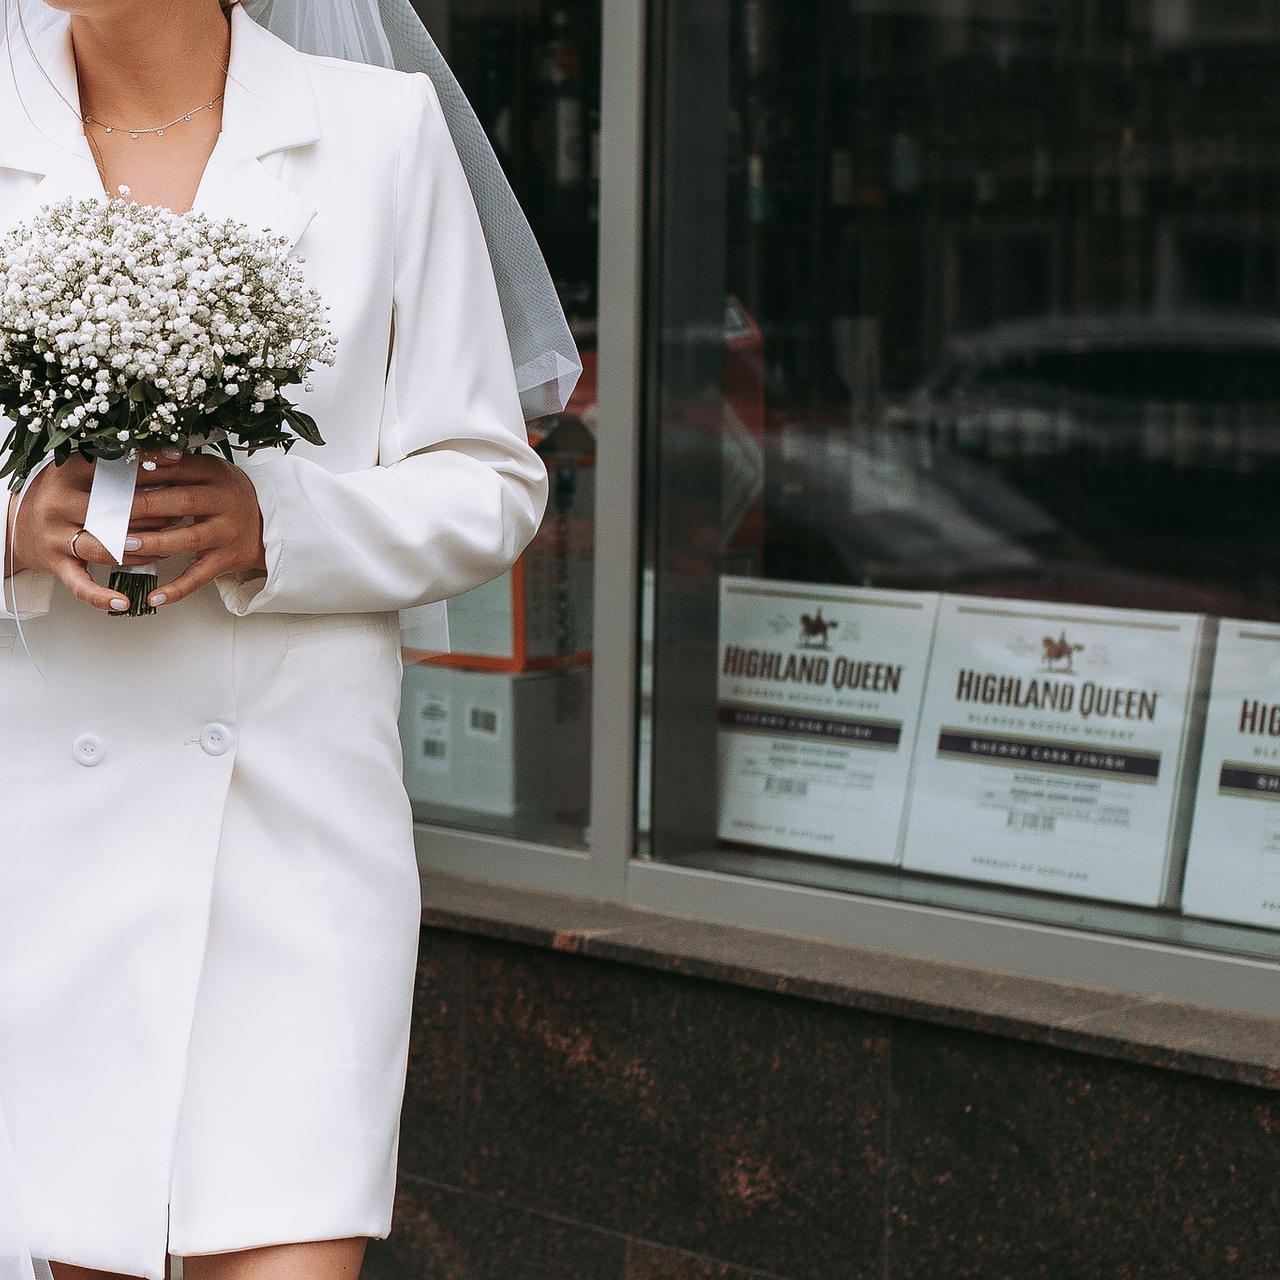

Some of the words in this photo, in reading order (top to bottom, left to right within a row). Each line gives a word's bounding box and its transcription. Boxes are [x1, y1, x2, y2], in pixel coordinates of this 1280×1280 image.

[722, 644, 829, 685] HIGHLAND
[831, 655, 904, 694] QUEEN
[956, 668, 1074, 712] HIGHLAND
[1079, 681, 1158, 722] QUEEN
[969, 739, 1027, 758] SHERRY
[1030, 745, 1070, 763] CASK
[1073, 750, 1126, 771] FINISH
